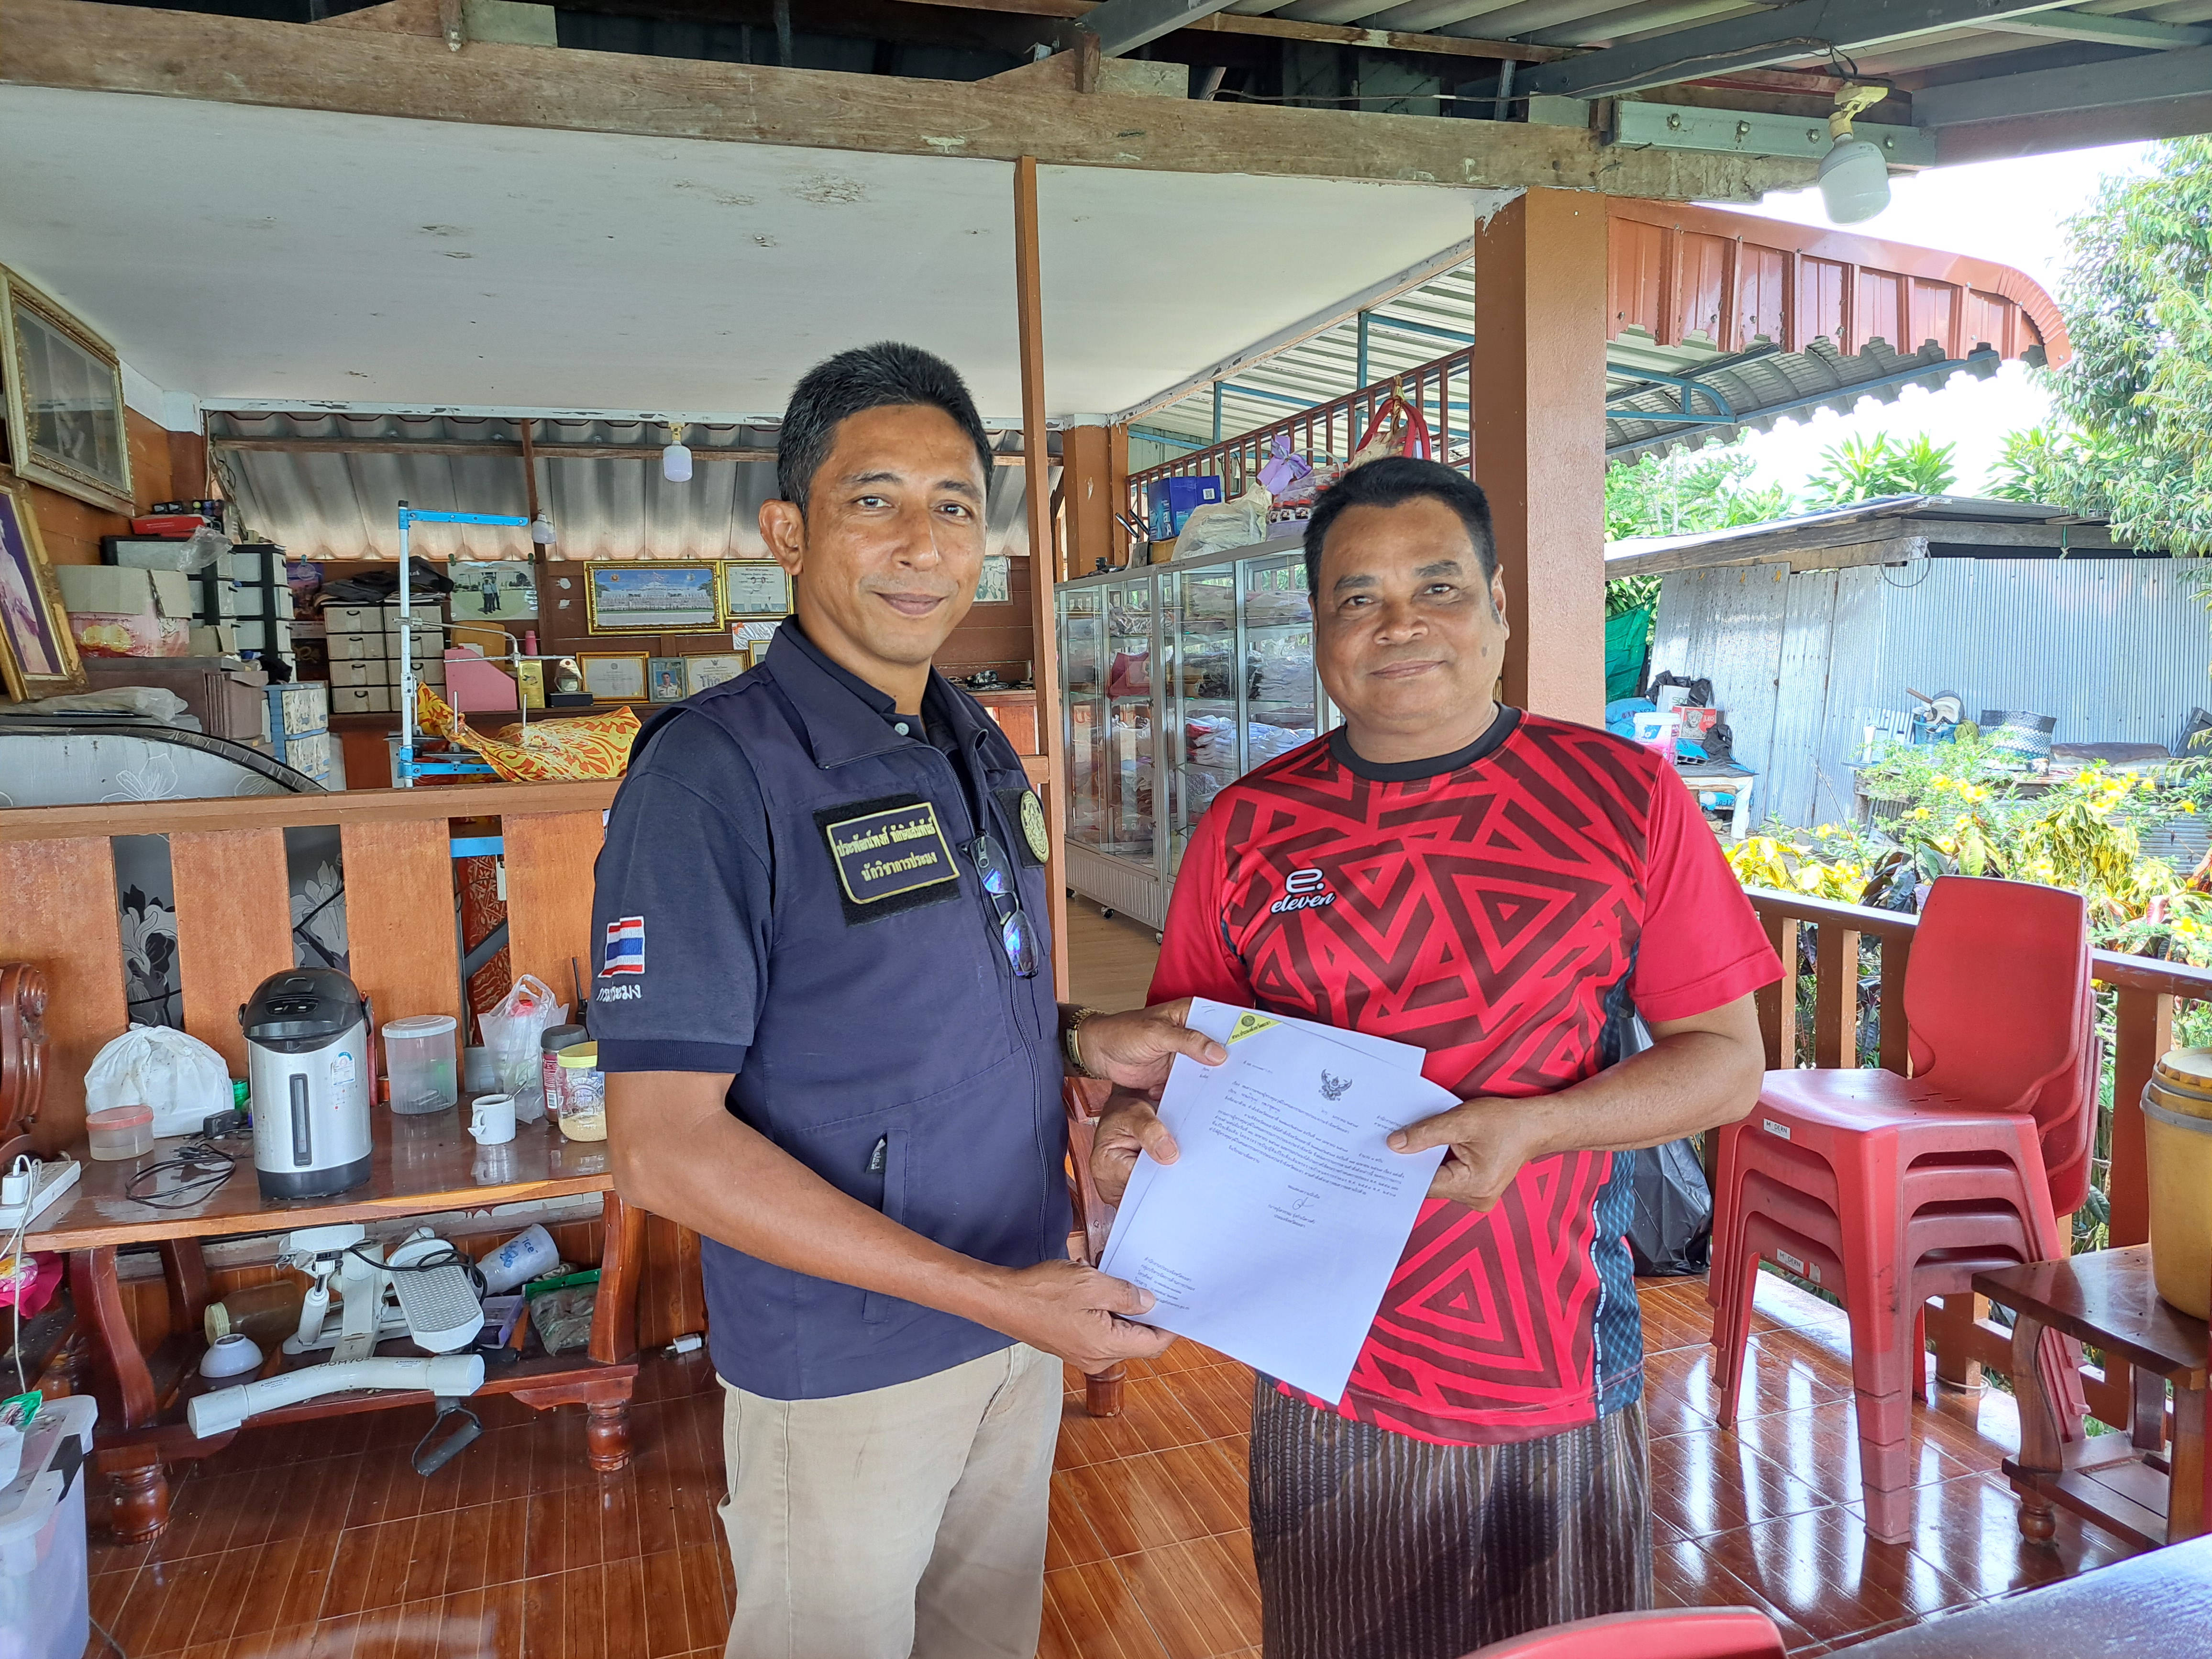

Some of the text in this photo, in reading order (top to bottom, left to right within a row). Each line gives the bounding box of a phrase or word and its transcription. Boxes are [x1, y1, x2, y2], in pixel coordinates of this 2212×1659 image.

[861, 851, 938, 881] นักวิชาการประมง
[1271, 892, 1335, 913] eleven
[1766, 1120, 1787, 1134] MDERN
[1780, 1251, 1801, 1267] MDERN
